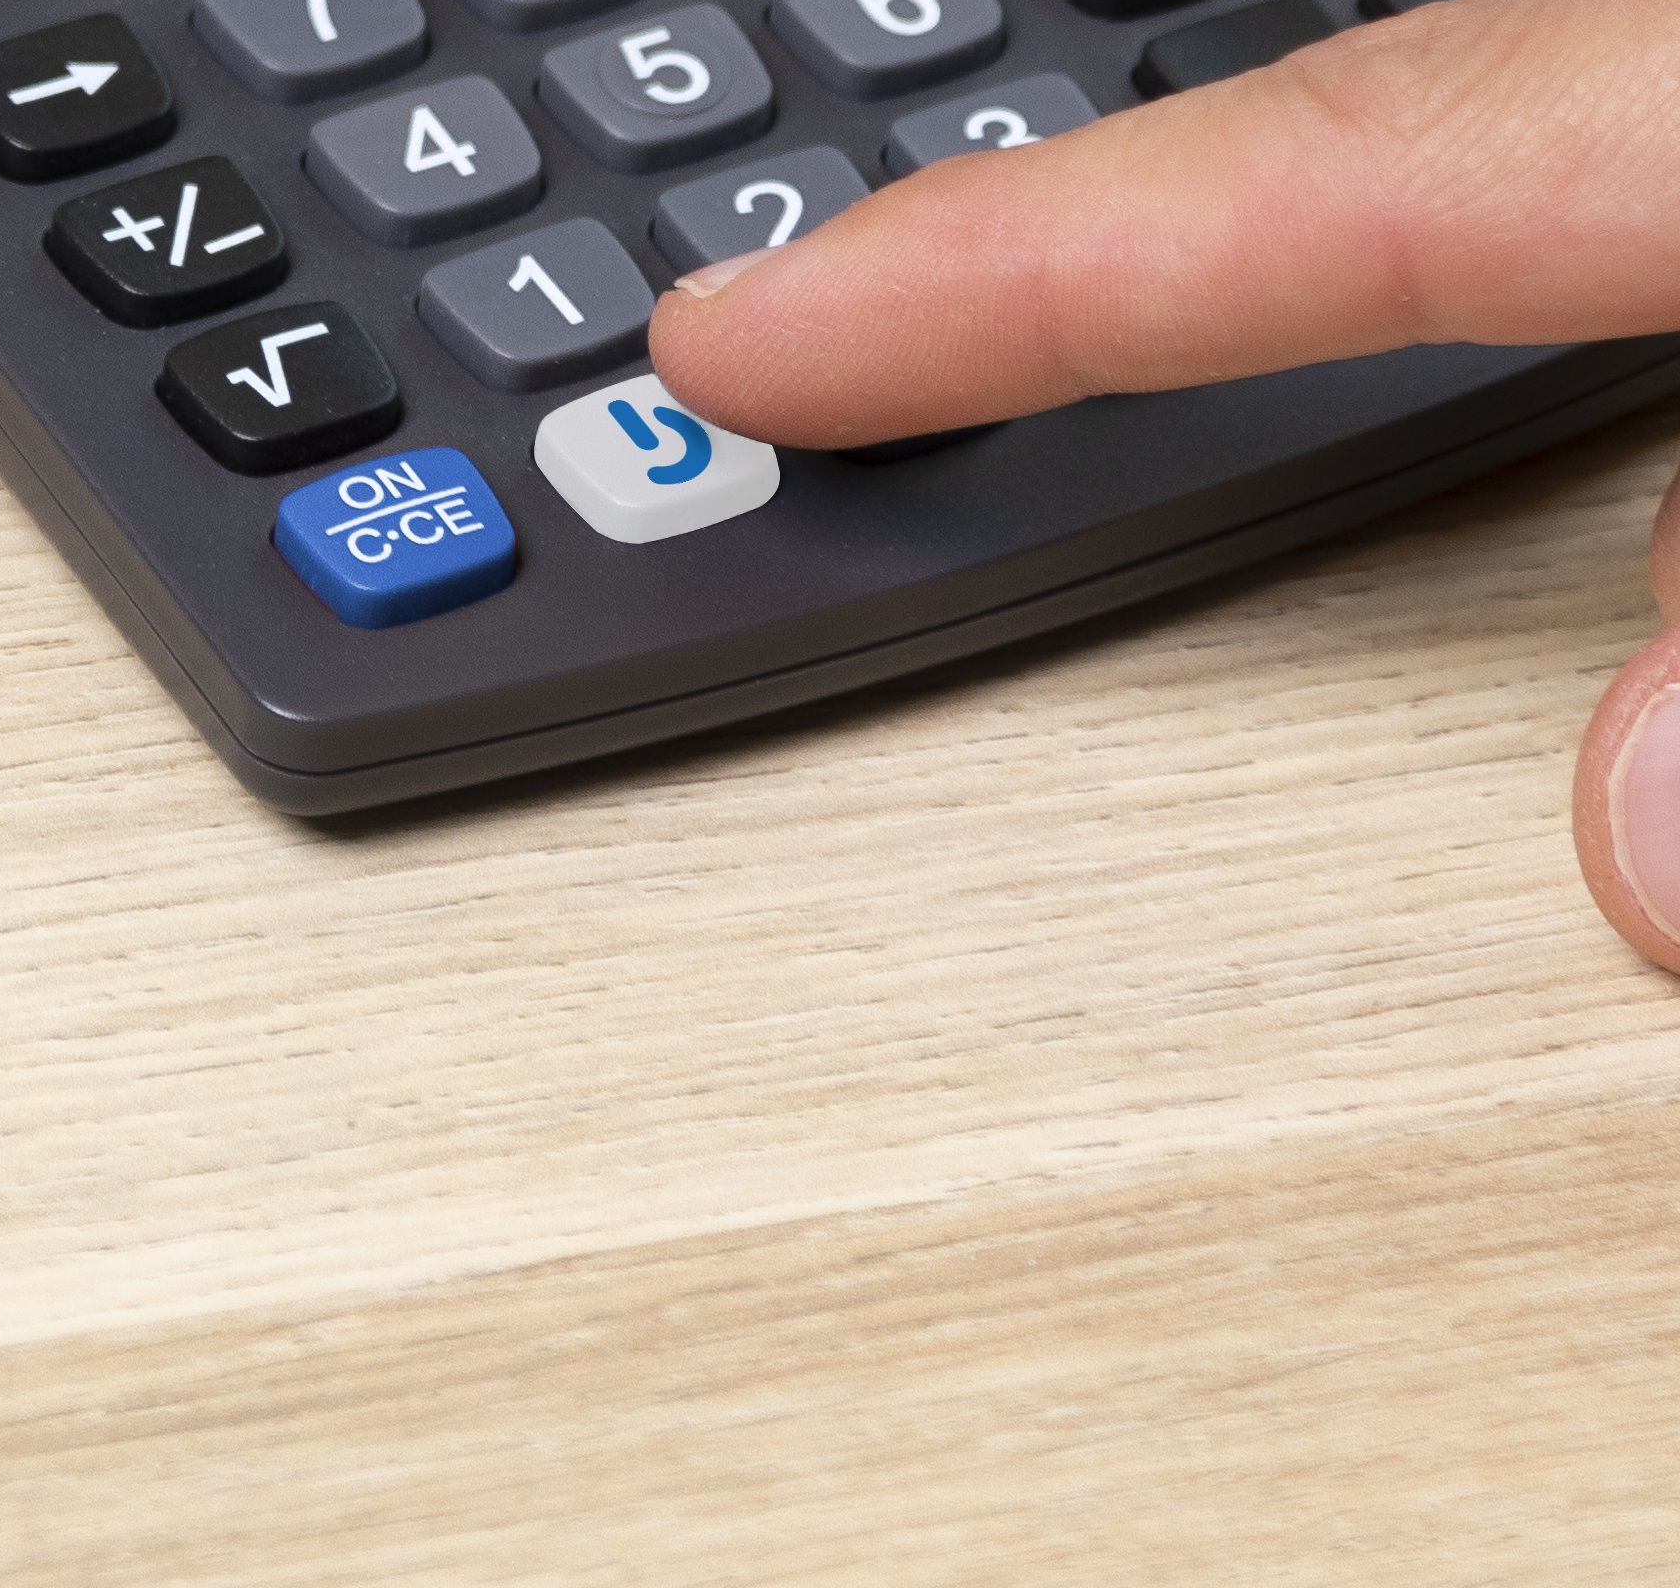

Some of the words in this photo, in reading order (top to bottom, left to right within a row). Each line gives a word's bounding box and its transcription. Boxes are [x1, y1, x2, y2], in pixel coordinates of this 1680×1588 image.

[619, 27, 711, 105] 5
[404, 105, 477, 178] 4
[733, 180, 804, 248] 2
[507, 254, 586, 326] 1
[337, 460, 428, 513] ON
